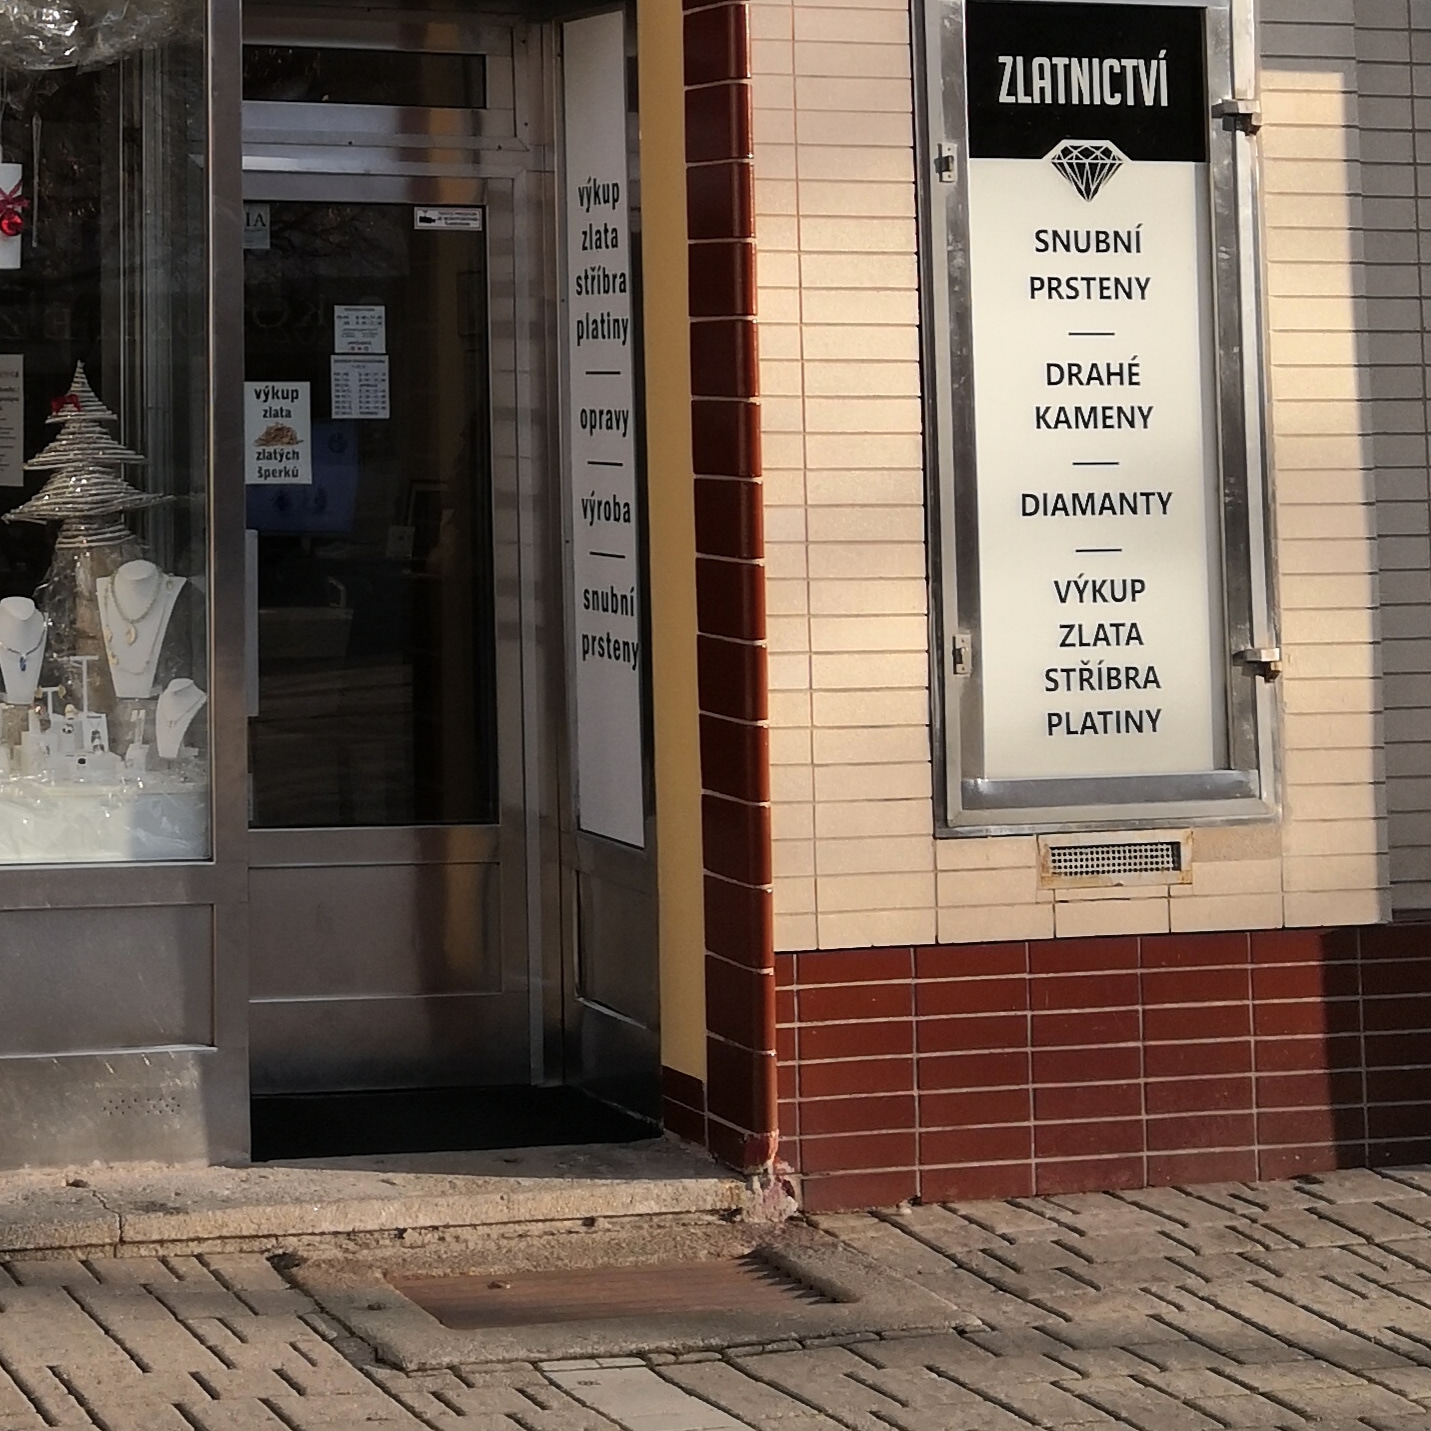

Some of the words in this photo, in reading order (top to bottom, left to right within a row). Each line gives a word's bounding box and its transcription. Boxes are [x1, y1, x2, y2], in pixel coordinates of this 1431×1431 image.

[999, 50, 1168, 106] ZLATNICTVÍ
[578, 177, 619, 213] výkup
[582, 223, 618, 251] zlata
[1036, 224, 1142, 253] SNUBNÍ
[576, 266, 627, 296] stříbra
[1030, 277, 1150, 299] PRSTENY
[577, 312, 628, 346] platiny
[1047, 355, 1140, 385] DRAHÉ
[255, 386, 298, 403] výkup
[263, 407, 291, 418] zlata
[580, 409, 628, 437] opravy
[1036, 406, 1153, 429] KAMENY
[256, 449, 299, 463] zlatých
[258, 466, 298, 480] šperků
[582, 491, 630, 526] výroba
[1022, 492, 1172, 516] DIAMANTY
[584, 586, 634, 616] snubní
[1054, 573, 1145, 603] VÝKUP
[1060, 623, 1144, 647] ZLATA
[582, 632, 639, 670] prsteny
[1045, 660, 1161, 691] STŘÍBRA
[1048, 709, 1161, 736] PLATINY
